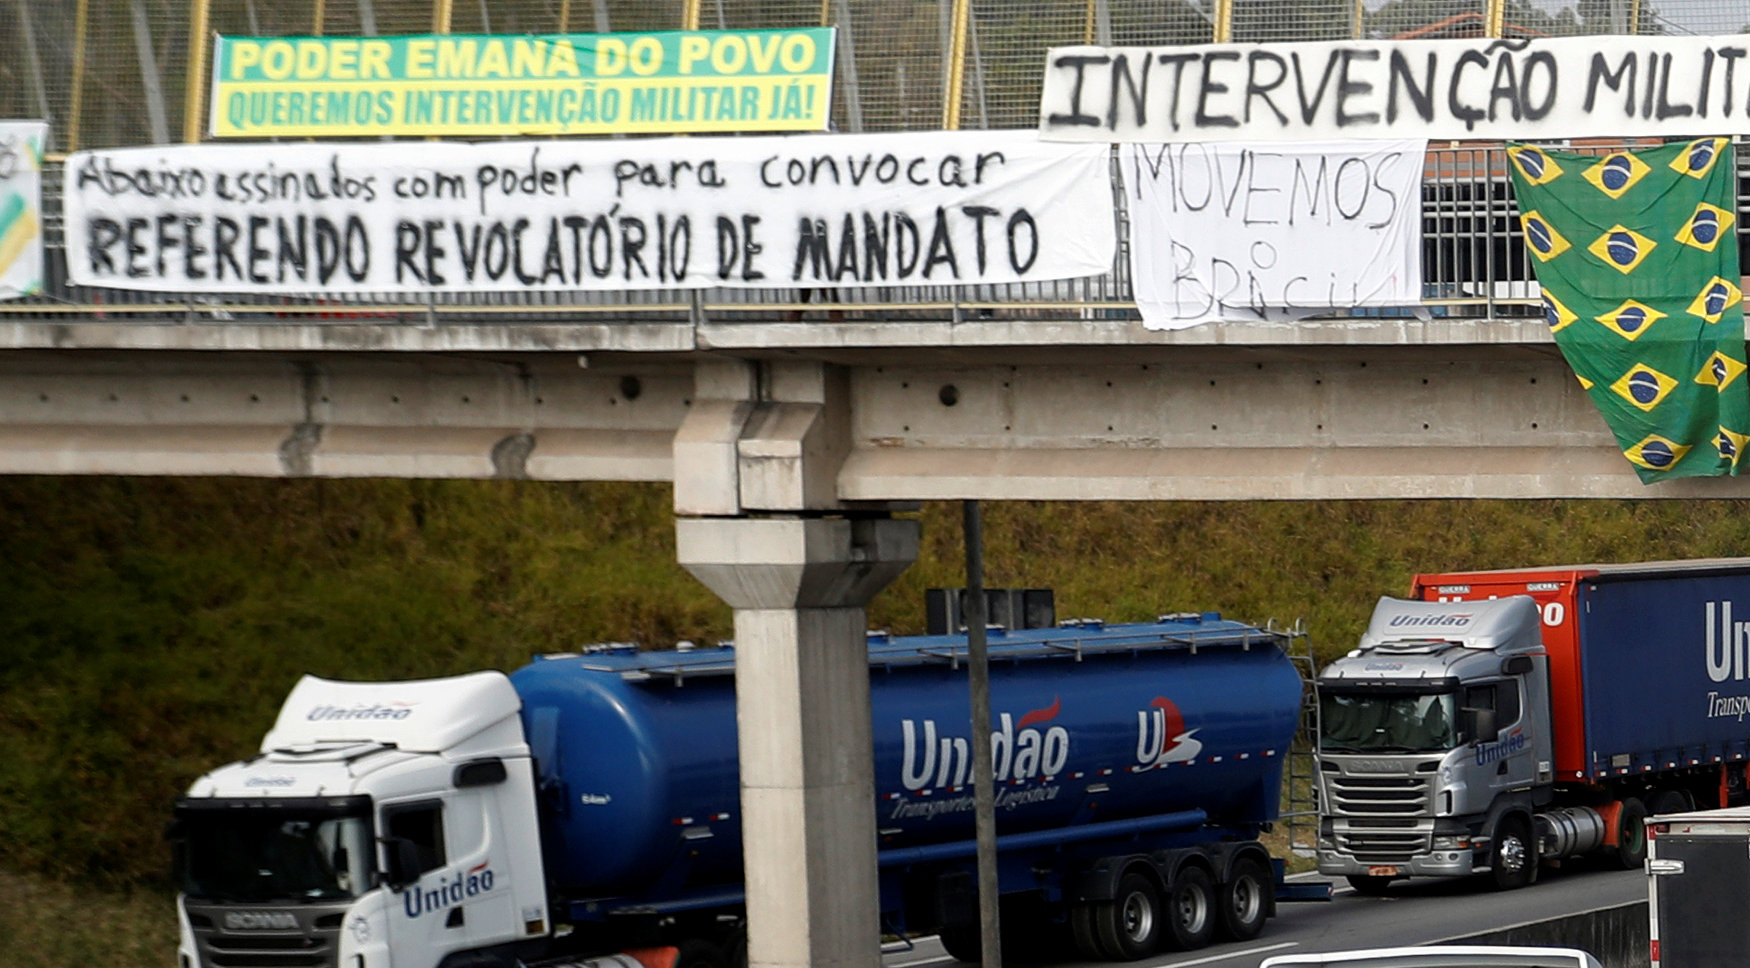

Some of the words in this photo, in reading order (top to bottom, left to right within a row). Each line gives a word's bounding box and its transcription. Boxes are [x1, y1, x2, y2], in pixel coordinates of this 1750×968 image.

[230, 39, 391, 80] PODER
[405, 37, 581, 77] EMANA
[595, 36, 664, 76] DO
[678, 34, 816, 75] POVO
[1048, 40, 1559, 132] INTERVENÇÃO
[227, 87, 395, 130] QUEREMOS
[403, 82, 619, 131] INTERVENÇÃO
[630, 85, 759, 123] MILITAR
[768, 78, 815, 120] JÁ!
[77, 155, 207, 199] Abaixo
[394, 172, 467, 199] com
[477, 147, 582, 215] poder
[614, 156, 726, 197] para
[760, 150, 1005, 188] convocar
[1133, 142, 1402, 229] MOVEMOS
[87, 213, 371, 286] REFERENDO
[396, 202, 691, 286] REVOCATÓRIO
[717, 215, 766, 281] DE
[793, 206, 1039, 283] MANDATO
[901, 692, 1069, 792] Undão
